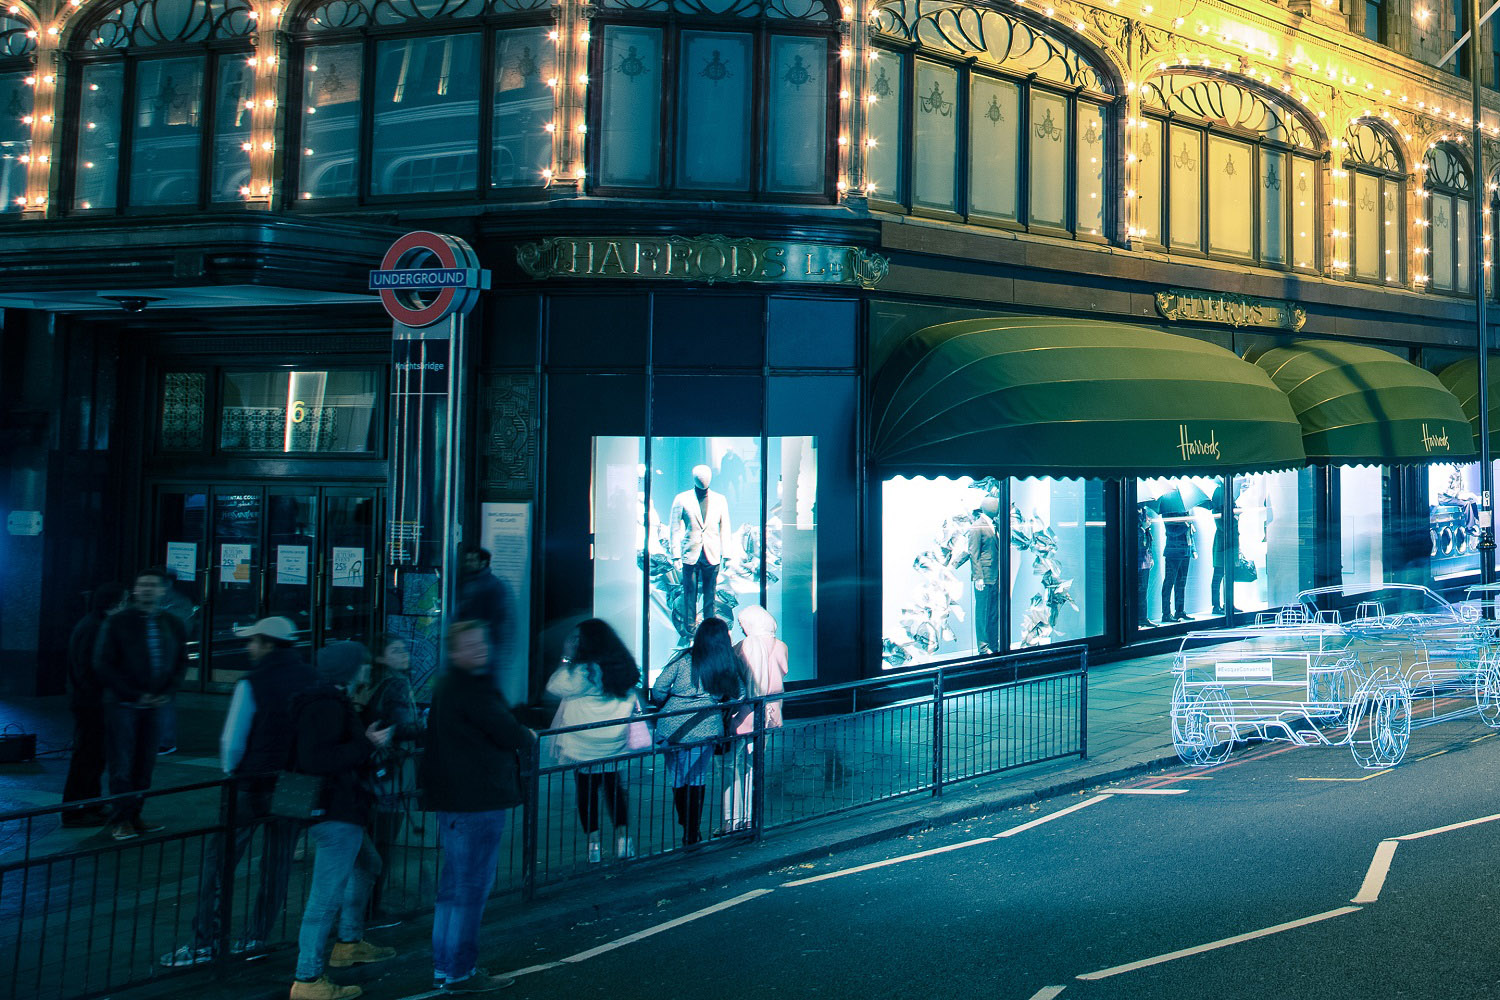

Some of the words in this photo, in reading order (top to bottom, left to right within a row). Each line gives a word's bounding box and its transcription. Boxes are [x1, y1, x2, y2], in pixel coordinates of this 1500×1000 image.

[564, 241, 787, 278] HARRODS
[373, 272, 465, 285] UNDERGROUND
[1179, 294, 1263, 324] HARRODS
[292, 400, 305, 423] 6
[1176, 424, 1221, 461] Harrods
[1420, 423, 1450, 453] Harrods
